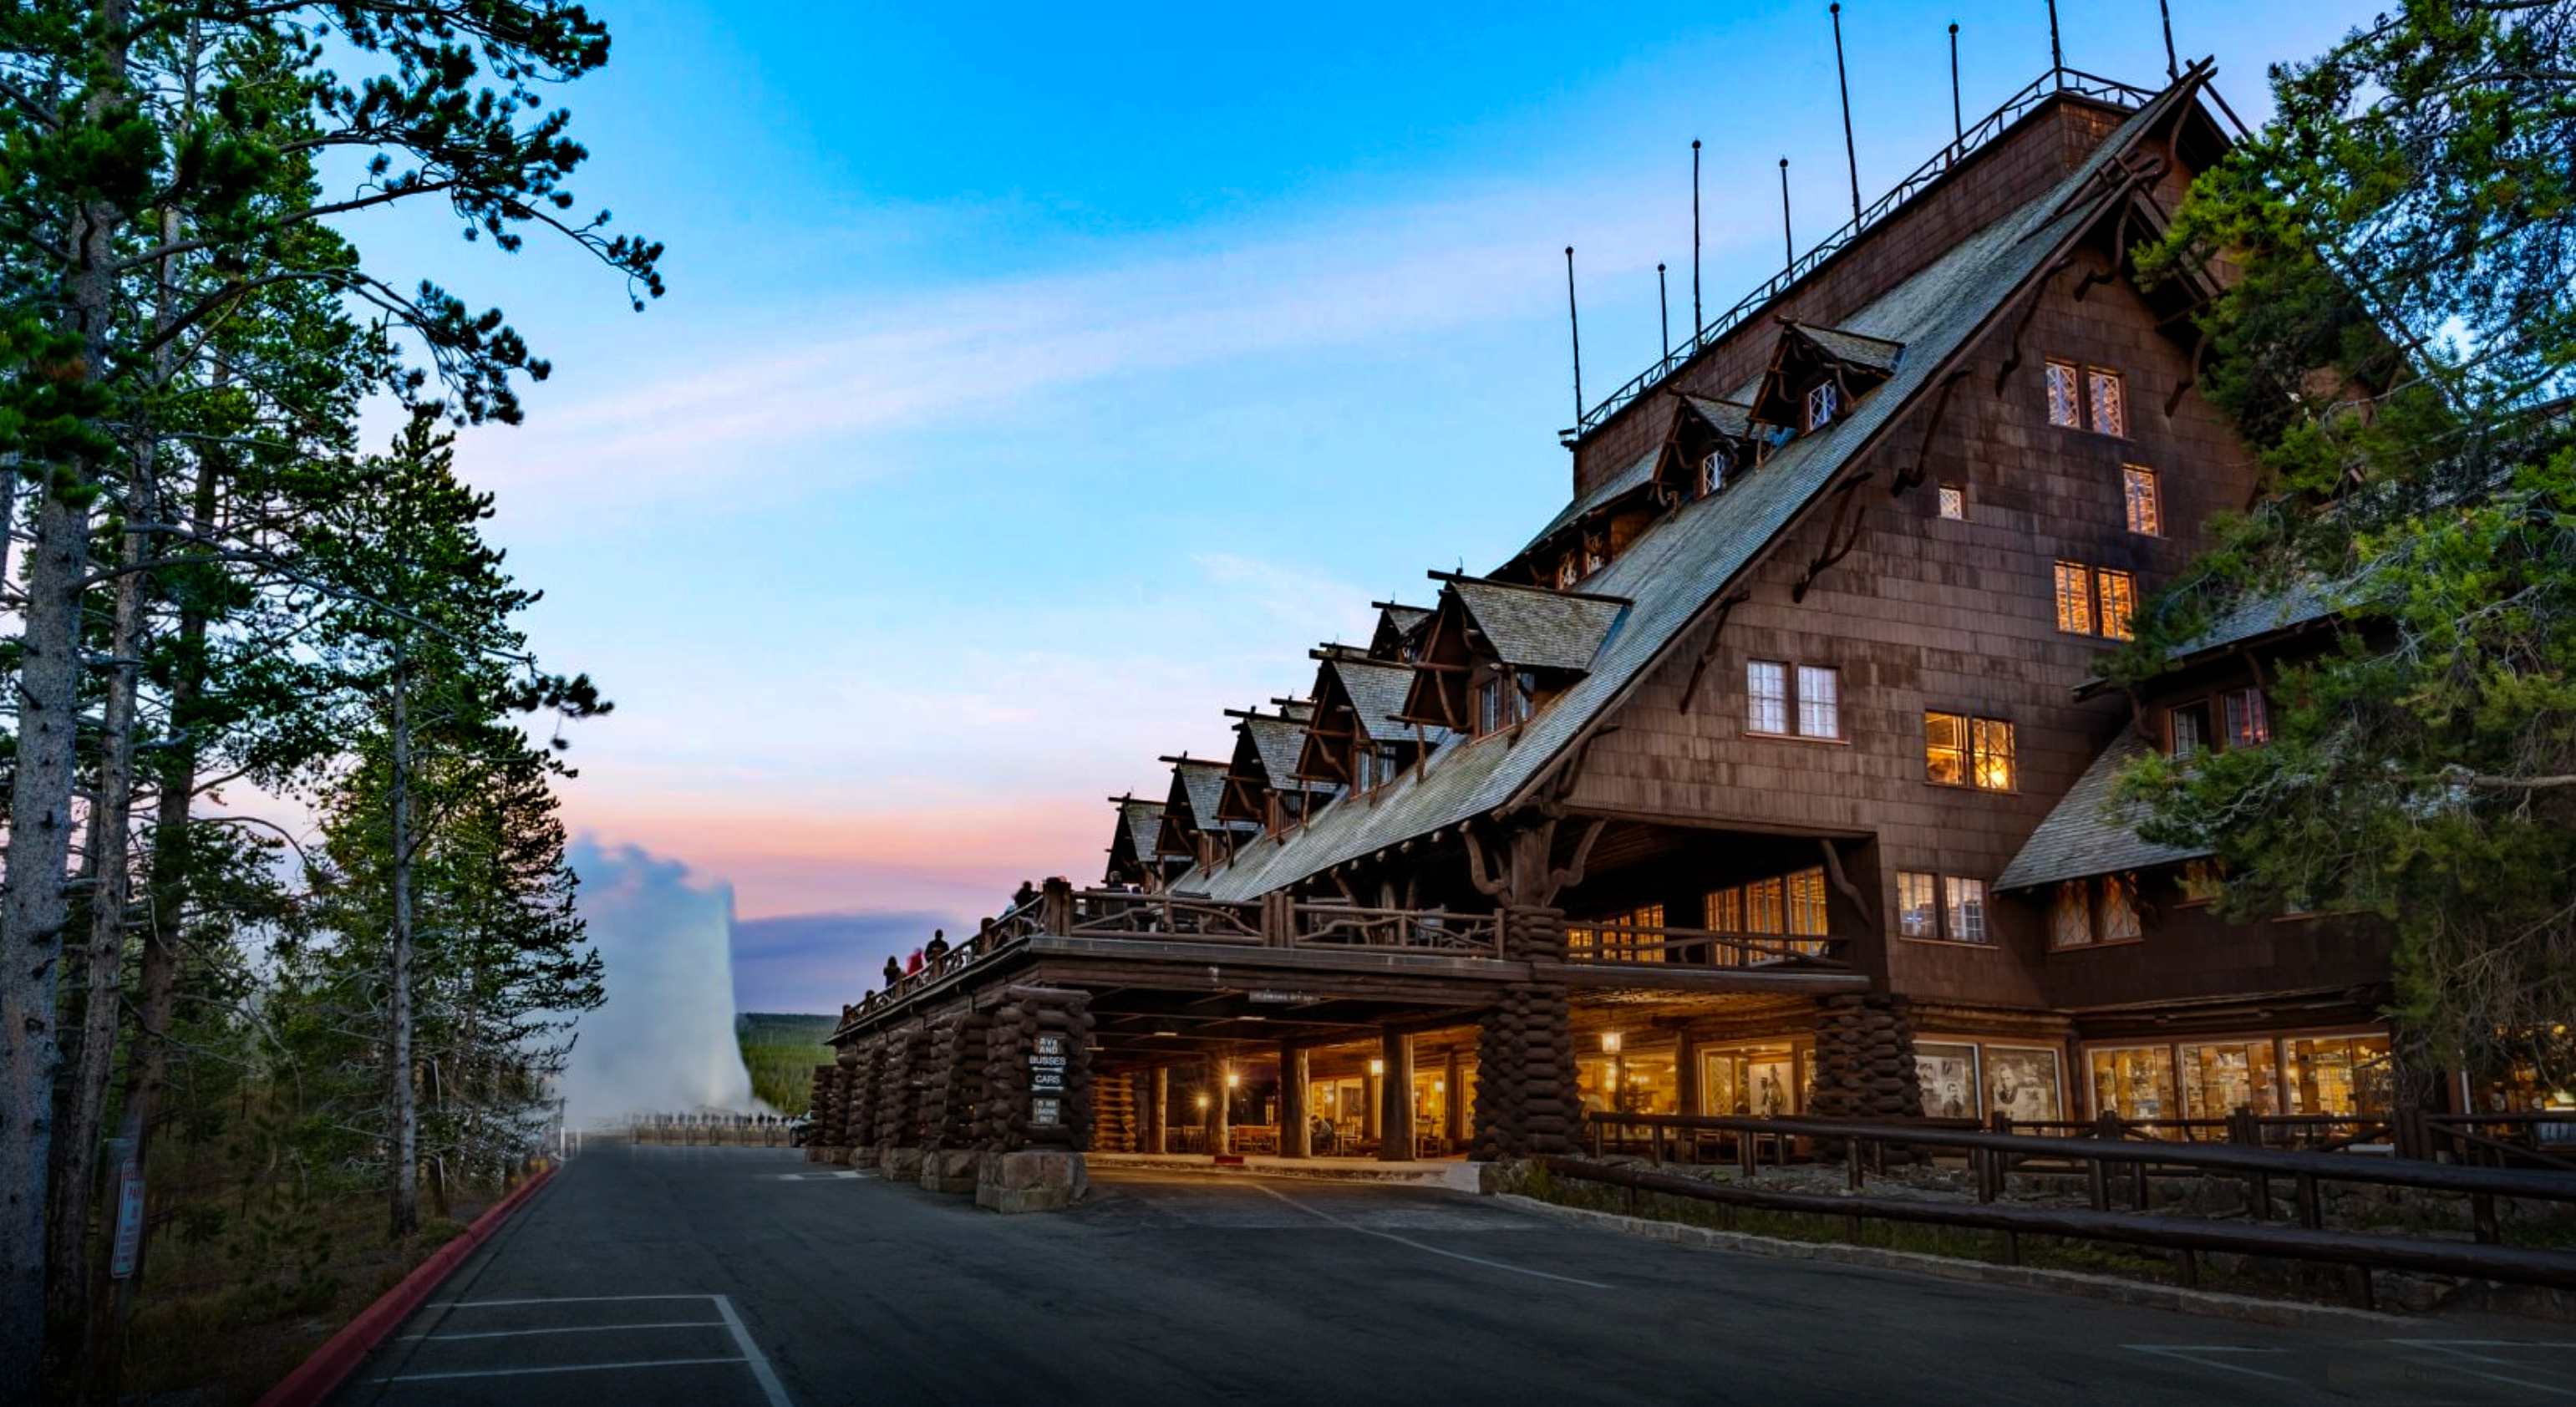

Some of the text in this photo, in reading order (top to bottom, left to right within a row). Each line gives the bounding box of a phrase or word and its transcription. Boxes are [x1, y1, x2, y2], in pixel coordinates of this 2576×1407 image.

[1039, 1046, 1058, 1054] AND
[1029, 1055, 1066, 1065] BUSSES
[1035, 1074, 1060, 1084] CARS
